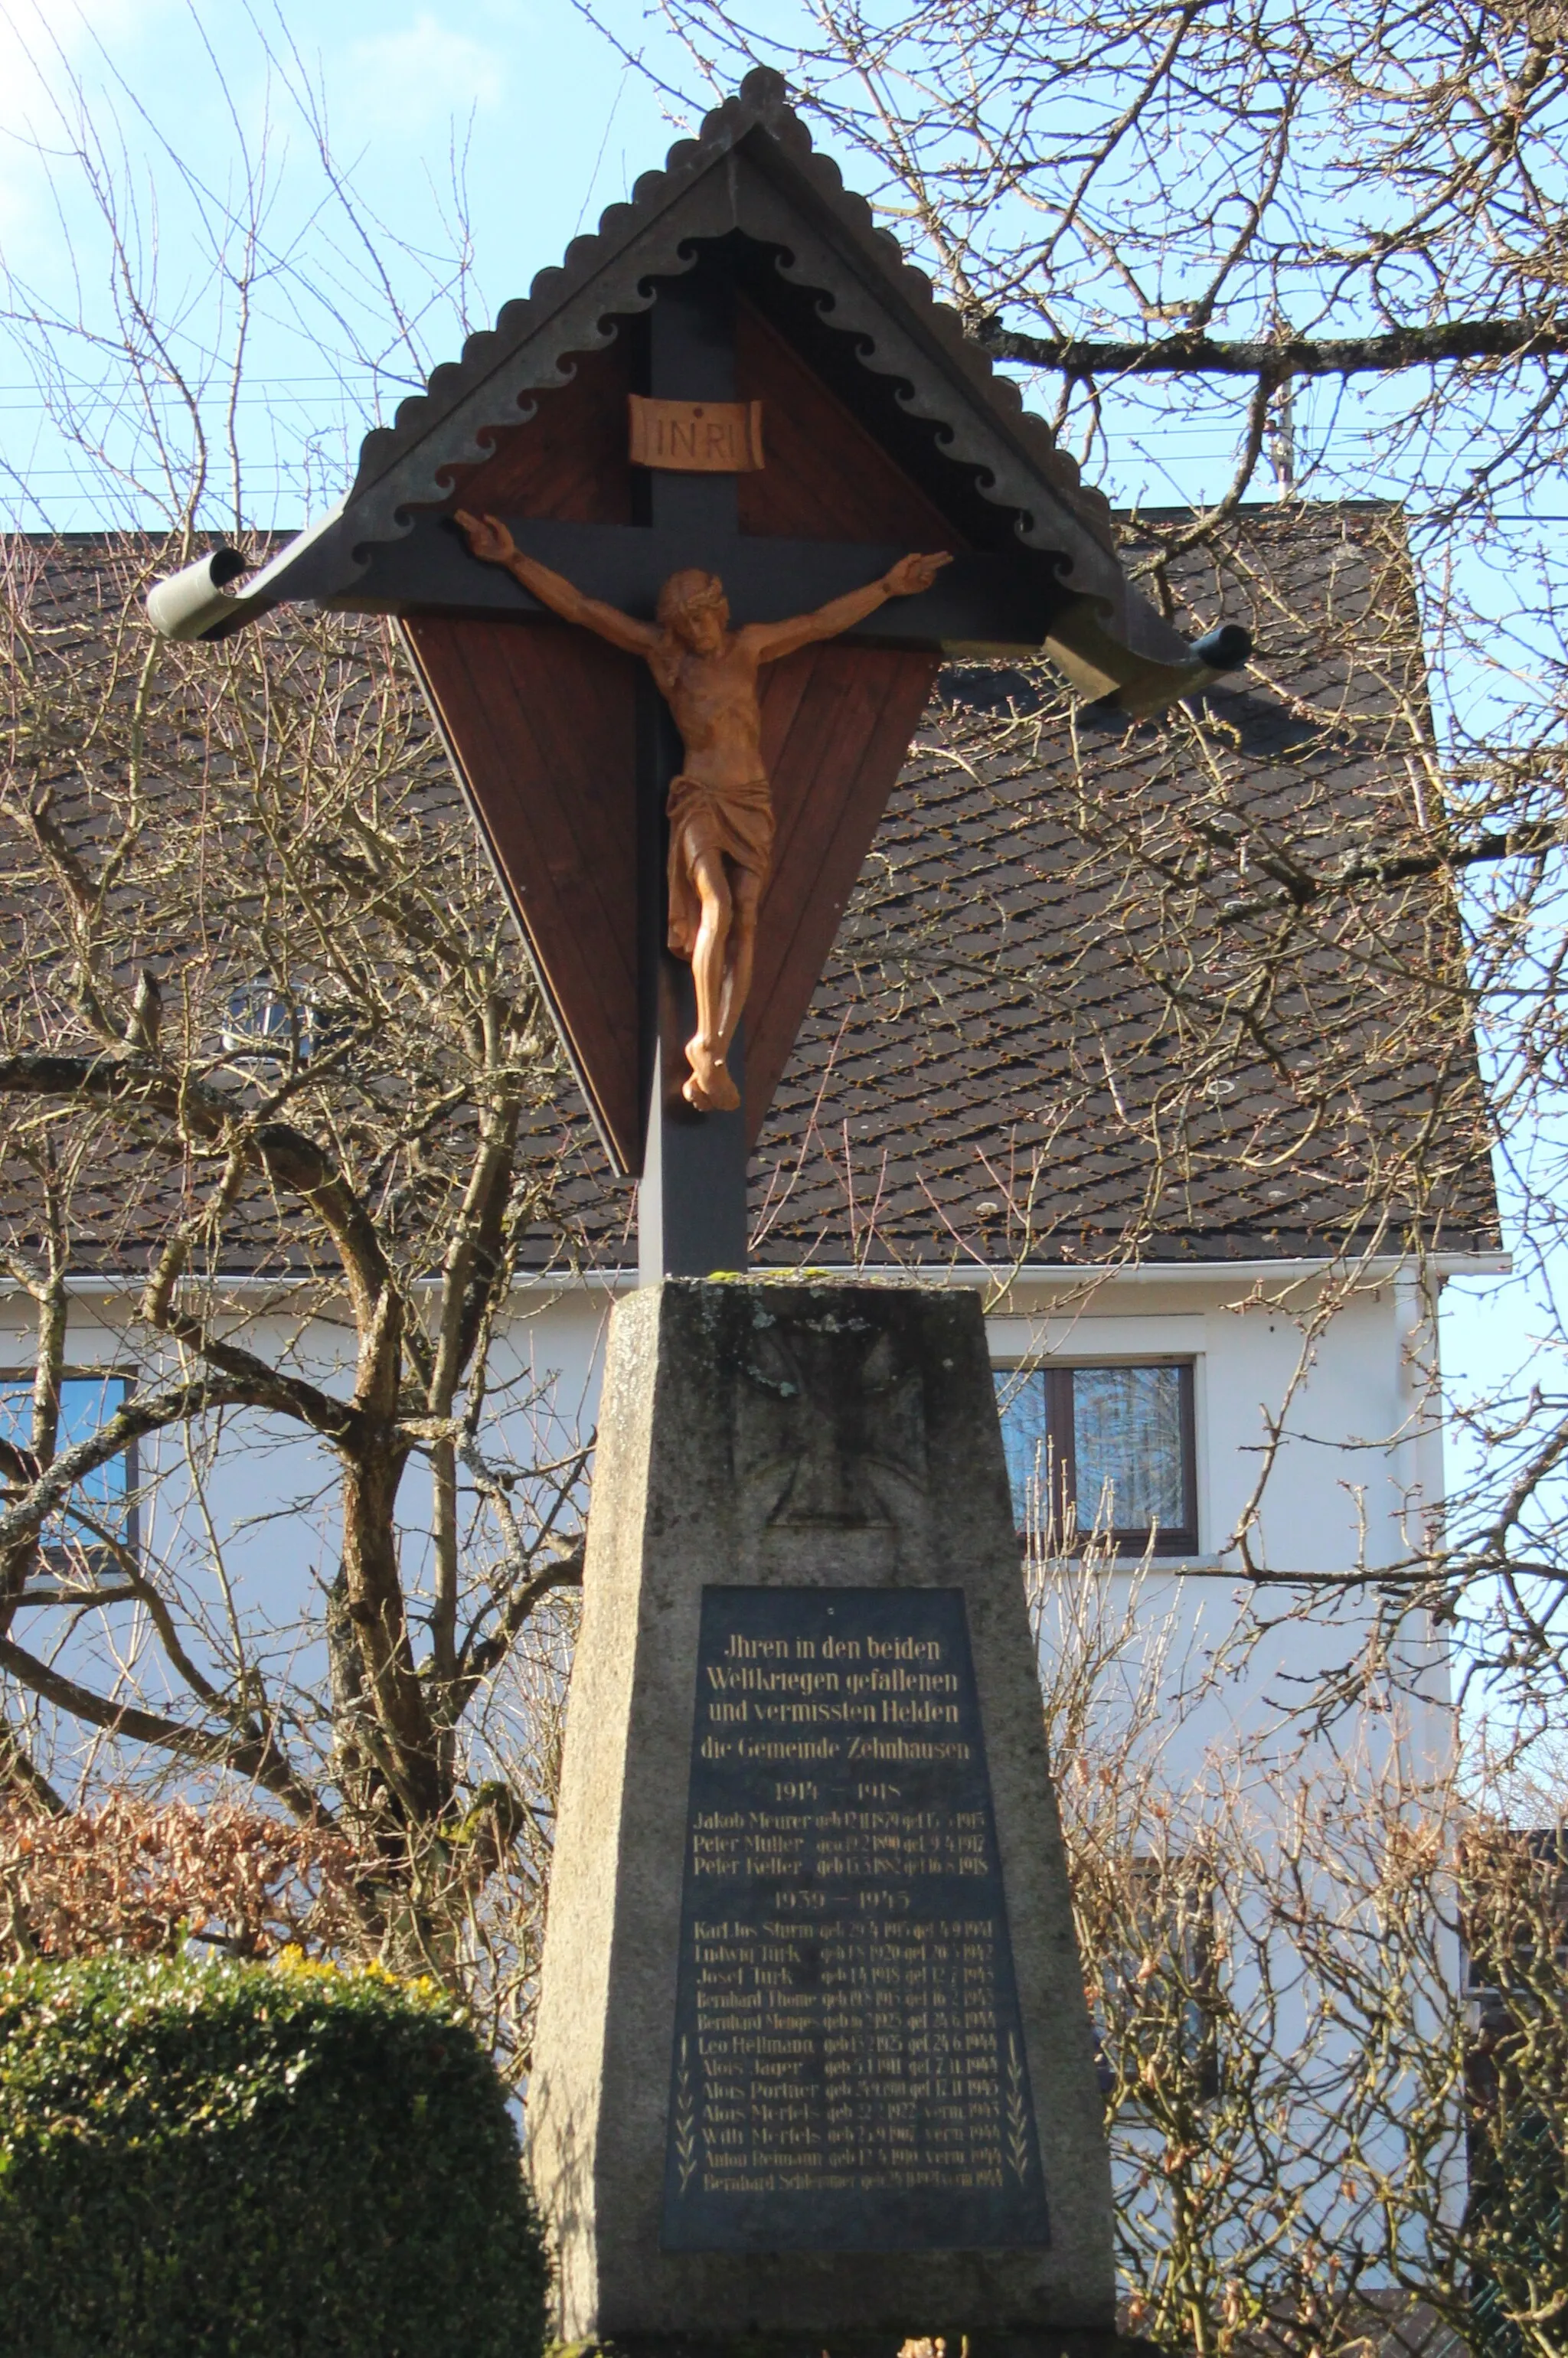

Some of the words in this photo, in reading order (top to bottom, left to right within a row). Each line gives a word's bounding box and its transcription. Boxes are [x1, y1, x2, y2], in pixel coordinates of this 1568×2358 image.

[657, 419, 736, 459] INRI
[795, 1636, 815, 1659] in
[822, 1635, 861, 1660] den
[867, 1636, 940, 1661] beiden
[706, 1667, 839, 1696] Weltkriegen
[846, 1667, 959, 1695] gefallenen
[708, 1700, 748, 1722] und
[753, 1700, 877, 1723] vermissten
[881, 1700, 959, 1723] Helden
[701, 1736, 732, 1759] die
[737, 1736, 840, 1759] Gemeinde
[846, 1736, 970, 1760] Zehnhausen
[775, 1781, 818, 1801] 1914
[858, 1783, 901, 1801] 1918
[693, 1811, 744, 1830] Jakob
[749, 1811, 812, 1830] Meurer
[693, 1834, 740, 1853] Peter
[694, 1856, 741, 1876] Peter
[746, 1856, 803, 1876] Keller
[775, 1889, 827, 1910] 1939
[859, 1890, 910, 1910] 1945
[694, 1920, 729, 1940] Karl
[762, 1921, 815, 1939] Sturm
[694, 1944, 755, 1964] Ludwig
[696, 1966, 744, 1986] Josef
[697, 1989, 763, 2009] Bernhard
[697, 2012, 763, 2031] Bernhard
[698, 2036, 729, 2056] Leo
[732, 2035, 815, 2056] Hellmann
[702, 2059, 744, 2077] Alois
[702, 2081, 746, 2100] Alois
[751, 2080, 820, 2100] Portner
[703, 2104, 746, 2122] Alois
[751, 2103, 821, 2122] Mertels
[752, 2125, 822, 2145] Mertels
[705, 2150, 747, 2168] Anton
[704, 2173, 775, 2192] Bernhard
